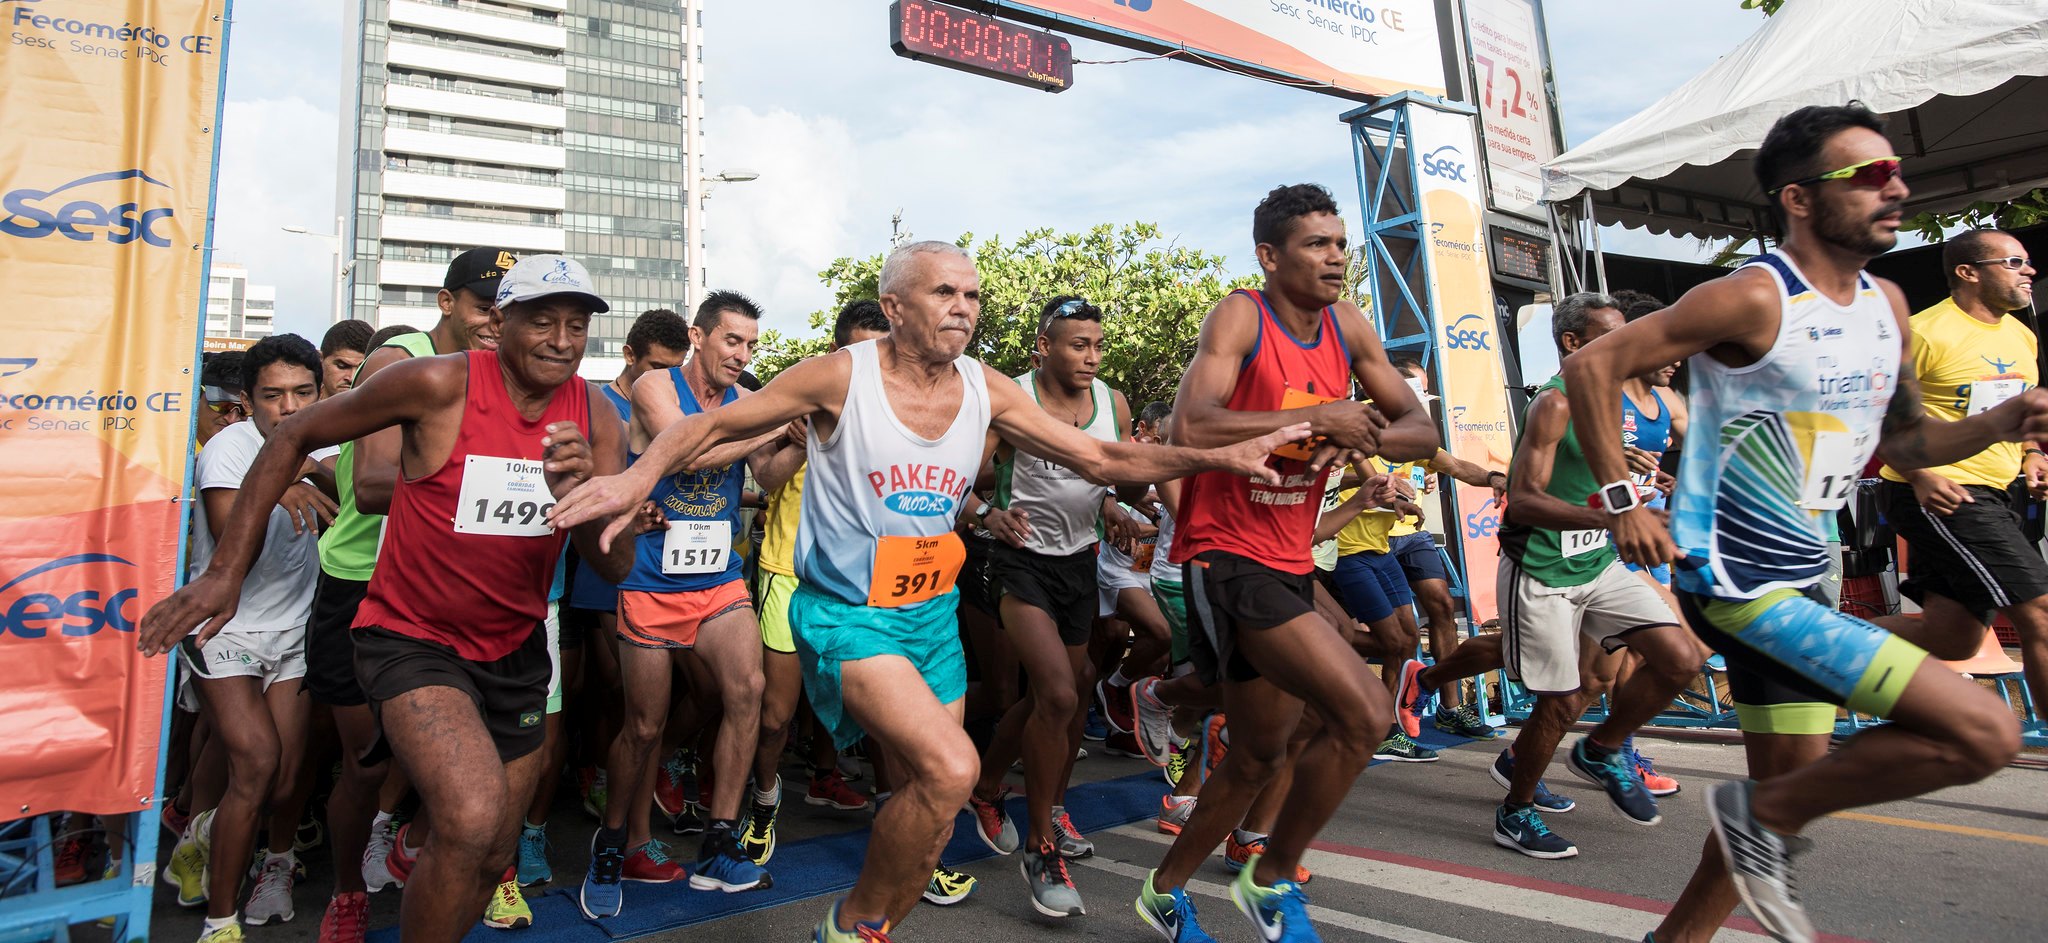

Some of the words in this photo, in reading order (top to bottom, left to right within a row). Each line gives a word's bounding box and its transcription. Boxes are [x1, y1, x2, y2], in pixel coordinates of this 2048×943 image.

[13, 6, 170, 49] Fecomércio
[180, 35, 213, 54] CE
[1270, 0, 1301, 20] Sesc
[1306, 10, 1345, 35] Senac
[1350, 24, 1379, 45] IPDC
[1381, 8, 1405, 32] CE
[11, 32, 56, 50] Sesc
[70, 40, 128, 60] Senac
[136, 46, 169, 66] IPDC
[1027, 68, 1064, 86] ChipTiming
[1476, 54, 1526, 119] 7,2
[1526, 91, 1539, 111] %
[1494, 125, 1516, 141] medida
[1516, 134, 1531, 146] certa
[1423, 148, 1467, 183] Sesc
[0, 180, 175, 248] Sesc
[203, 340, 227, 350] Beira
[228, 341, 247, 350] Mar
[1446, 320, 1491, 351] Sesc
[146, 392, 182, 412] CE
[28, 416, 91, 431] Senac
[103, 416, 137, 431] IPDC
[1495, 421, 1506, 432] CE
[506, 462, 543, 475] 10km
[867, 463, 968, 502] PAKERA
[663, 494, 728, 517] MUSCULAÇÃO
[897, 493, 946, 512] MODAS
[688, 523, 711, 531] 10km
[1467, 512, 1501, 539] Ses
[915, 540, 939, 550] 5km
[671, 548, 722, 566] 1517
[891, 569, 941, 598] 391
[0, 584, 138, 638] esc
